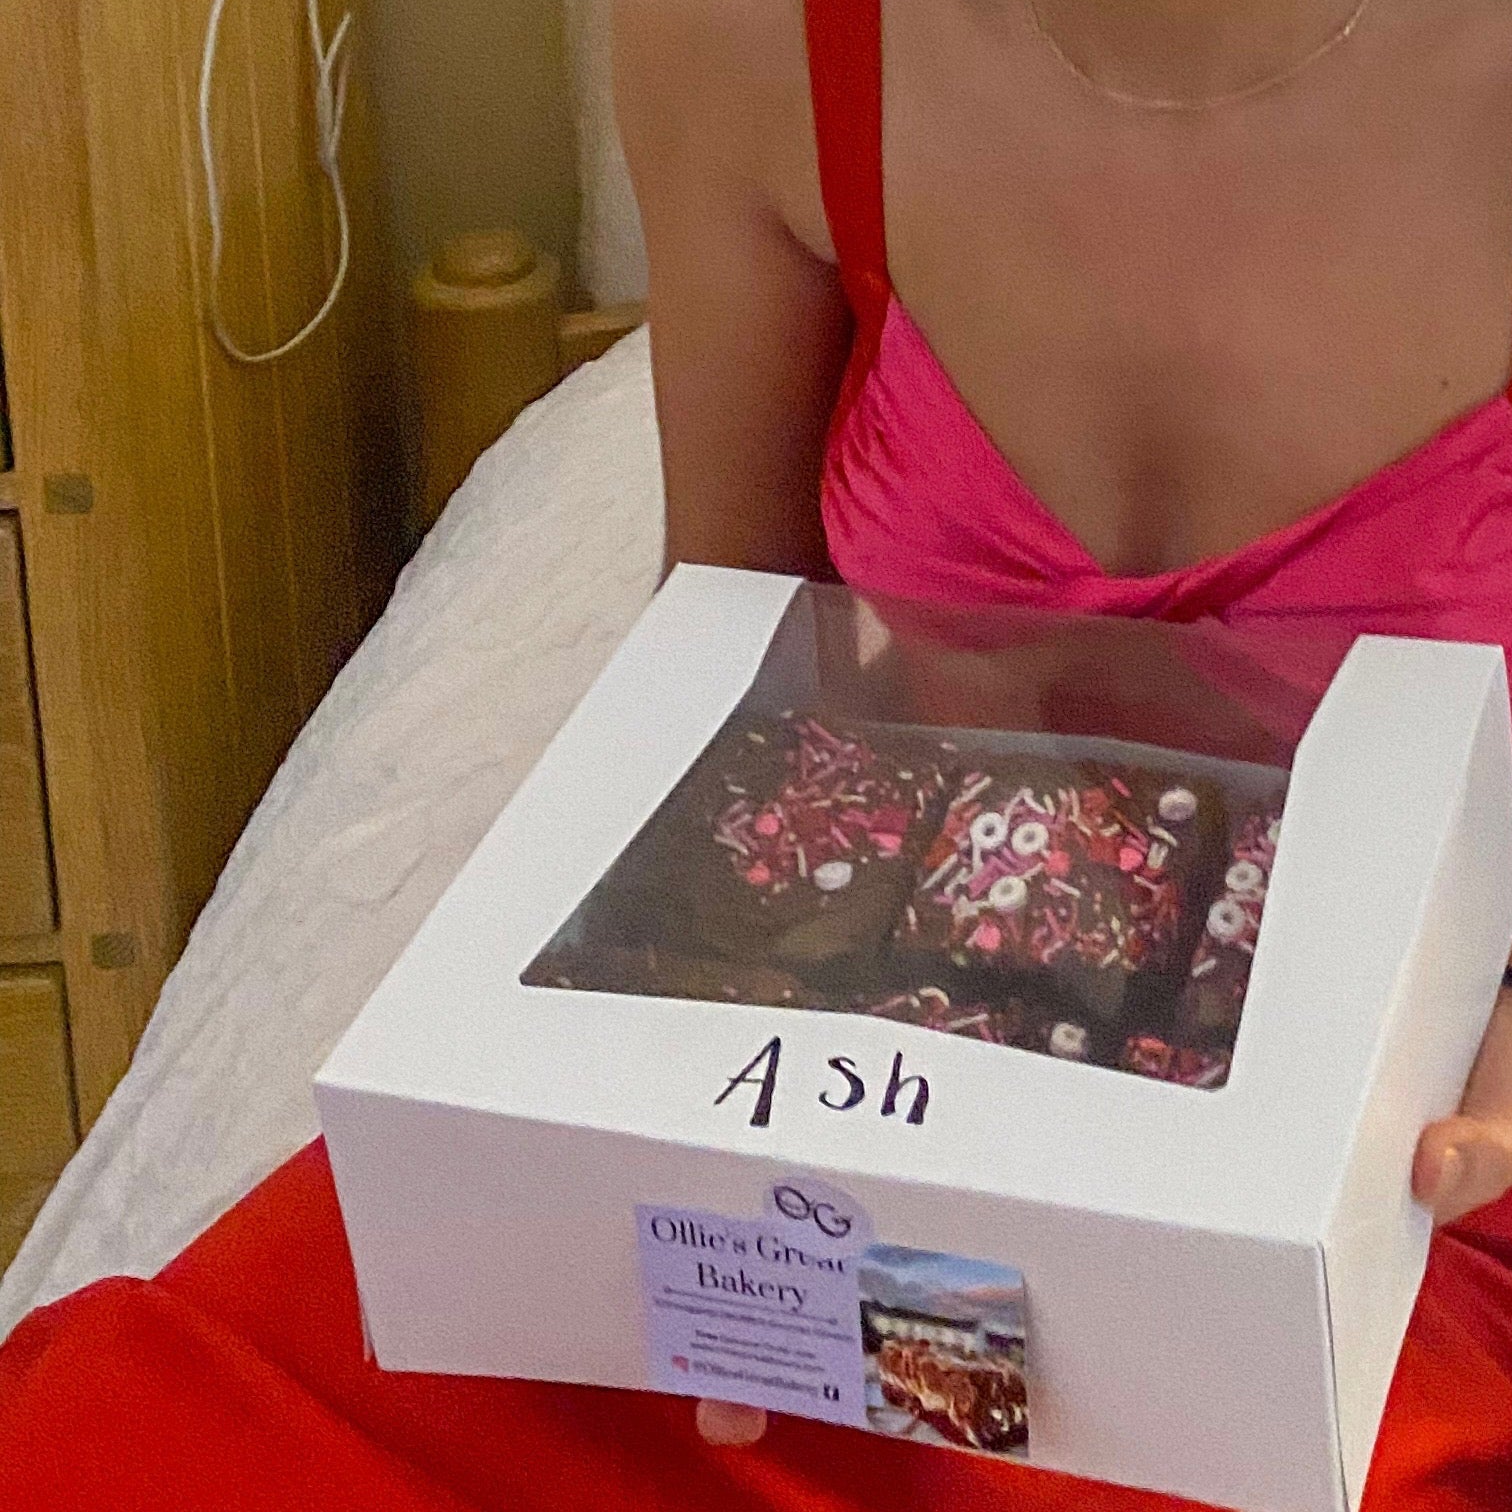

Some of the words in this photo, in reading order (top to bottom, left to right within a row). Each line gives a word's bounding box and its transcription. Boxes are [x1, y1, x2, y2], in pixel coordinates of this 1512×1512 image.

[713, 1035, 931, 1128] Ash
[651, 1215, 747, 1256] Ollie's
[696, 1261, 807, 1312] Bakery
